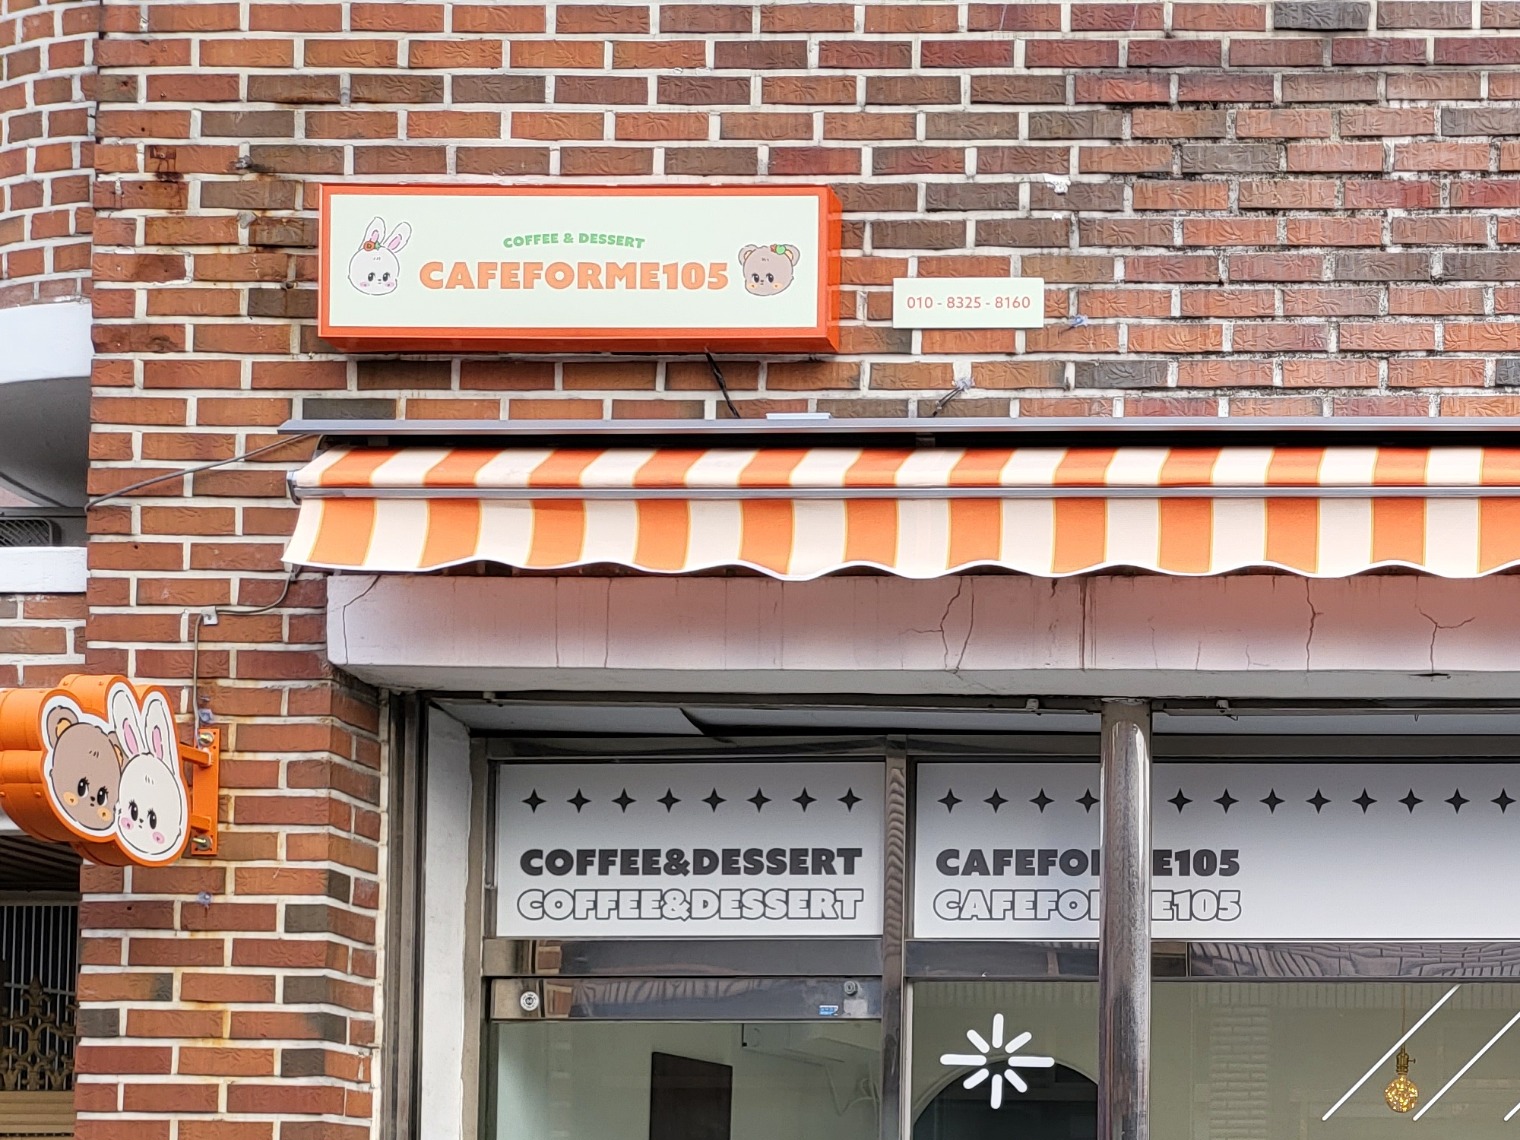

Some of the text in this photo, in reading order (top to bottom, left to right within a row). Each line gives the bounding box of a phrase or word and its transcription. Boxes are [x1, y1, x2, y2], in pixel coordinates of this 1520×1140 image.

[503, 232, 646, 249] COFFEE & DESSERT
[419, 261, 729, 290] CAFEFORME105
[519, 848, 862, 876] COFFEE&DESSERT
[935, 848, 1240, 877] CAFEFOE105
[517, 888, 863, 922] COFFEE&DESSERT
[933, 888, 1242, 922] CAFEFOE105
